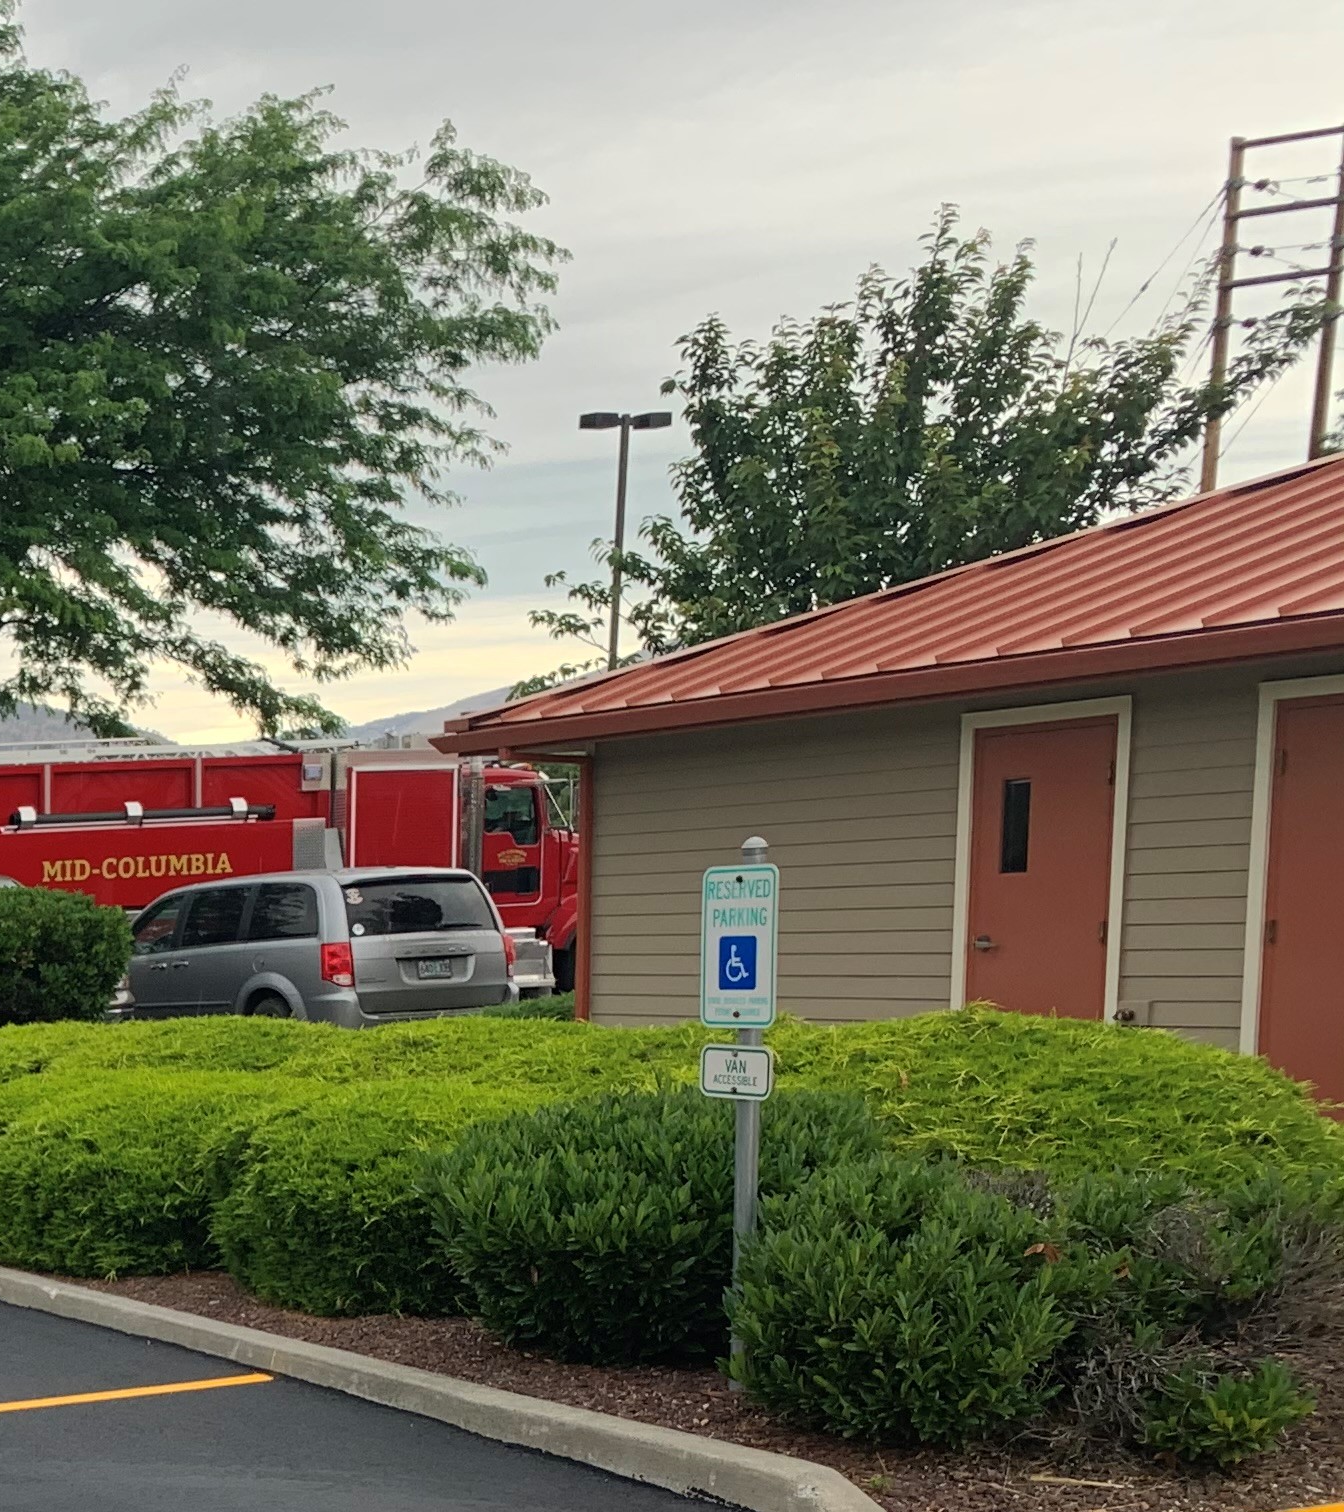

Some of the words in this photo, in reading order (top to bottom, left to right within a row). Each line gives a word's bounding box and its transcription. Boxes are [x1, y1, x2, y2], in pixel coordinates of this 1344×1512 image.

[42, 853, 233, 882] MID-COLUMBIA
[707, 879, 771, 899] RESERVED
[713, 907, 767, 927] PARKING
[725, 1059, 746, 1073] VAN
[713, 1074, 757, 1086] ACCESSIBLE
